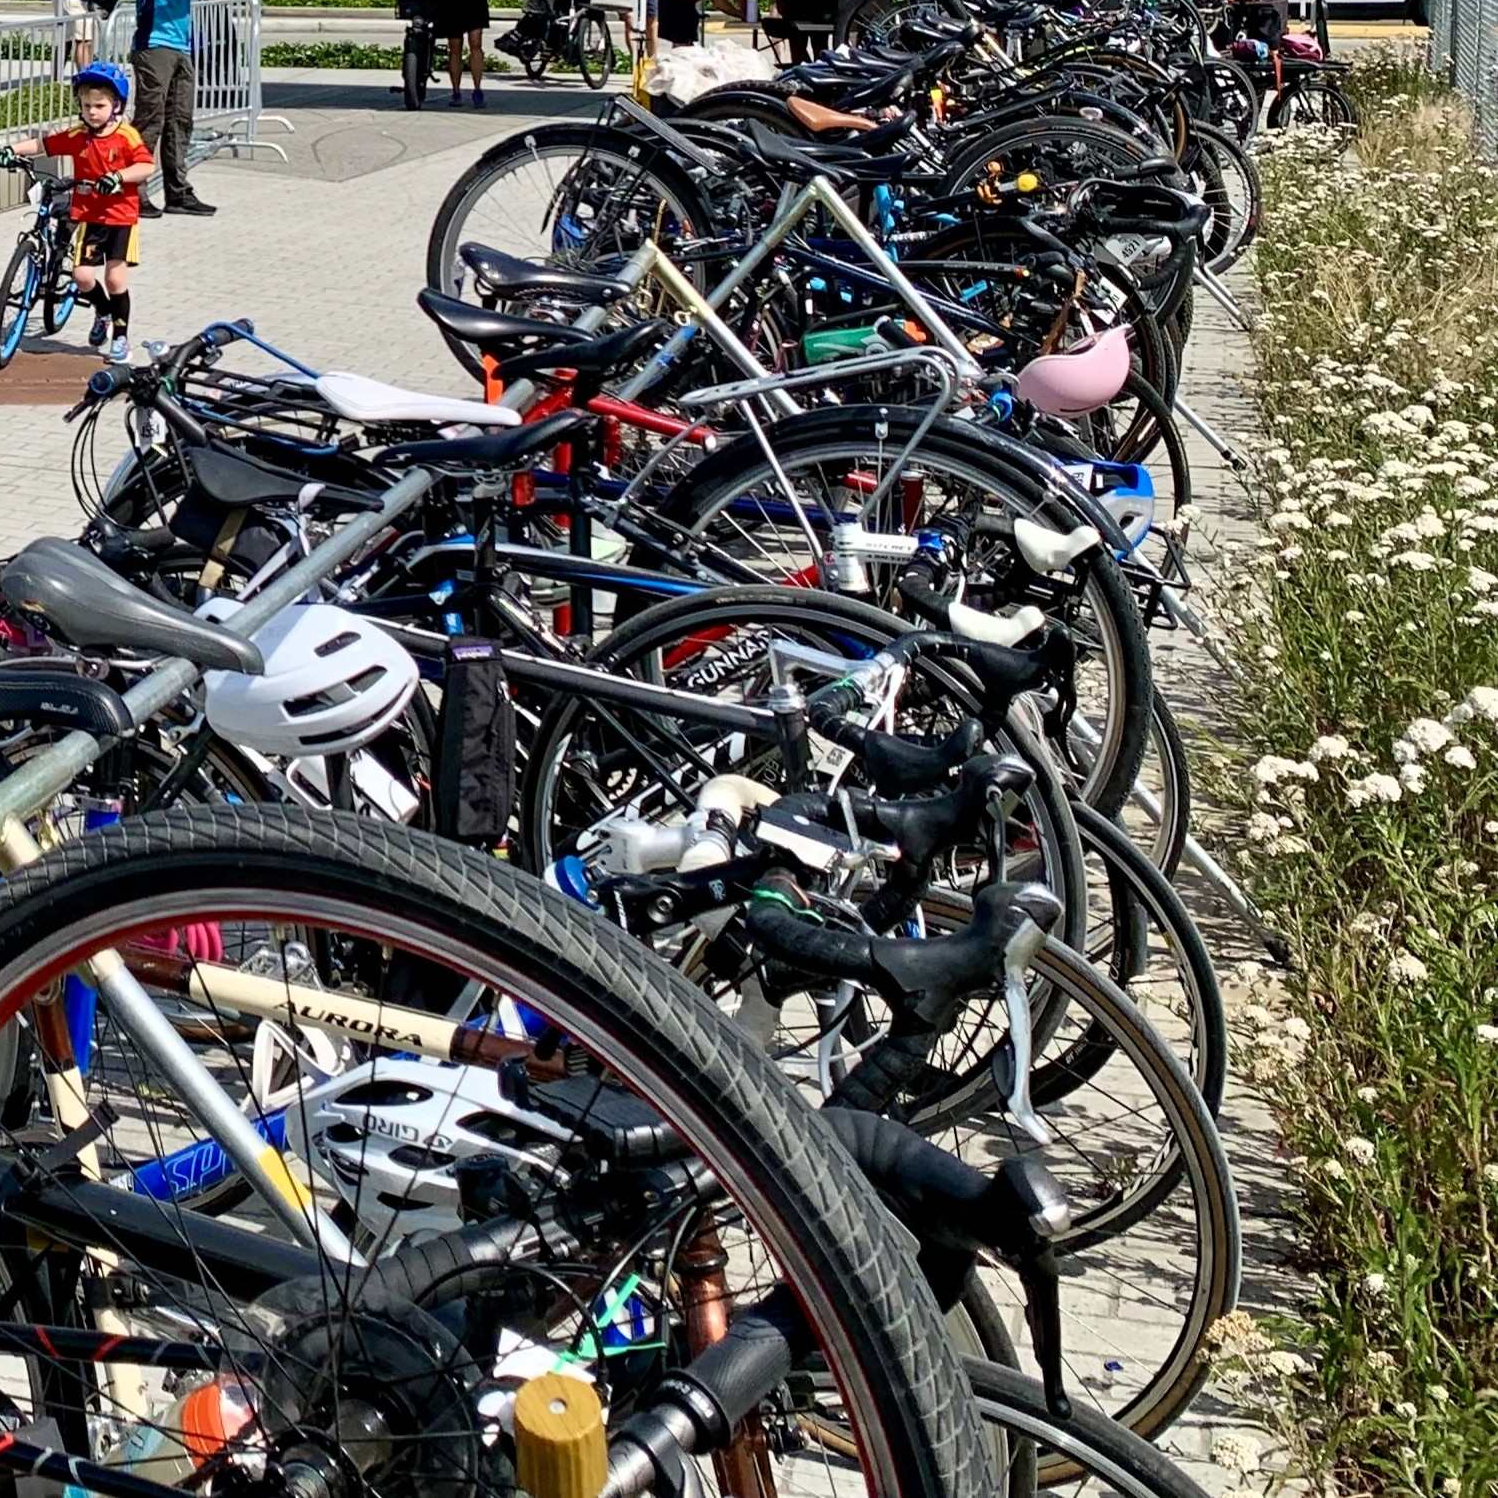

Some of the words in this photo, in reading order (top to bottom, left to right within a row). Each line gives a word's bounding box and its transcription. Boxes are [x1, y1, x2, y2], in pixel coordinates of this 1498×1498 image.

[1121, 239, 1141, 259] 4521
[687, 630, 769, 688] GUNNAR
[273, 1001, 423, 1048] AURORA
[362, 1113, 420, 1143] GIRO
